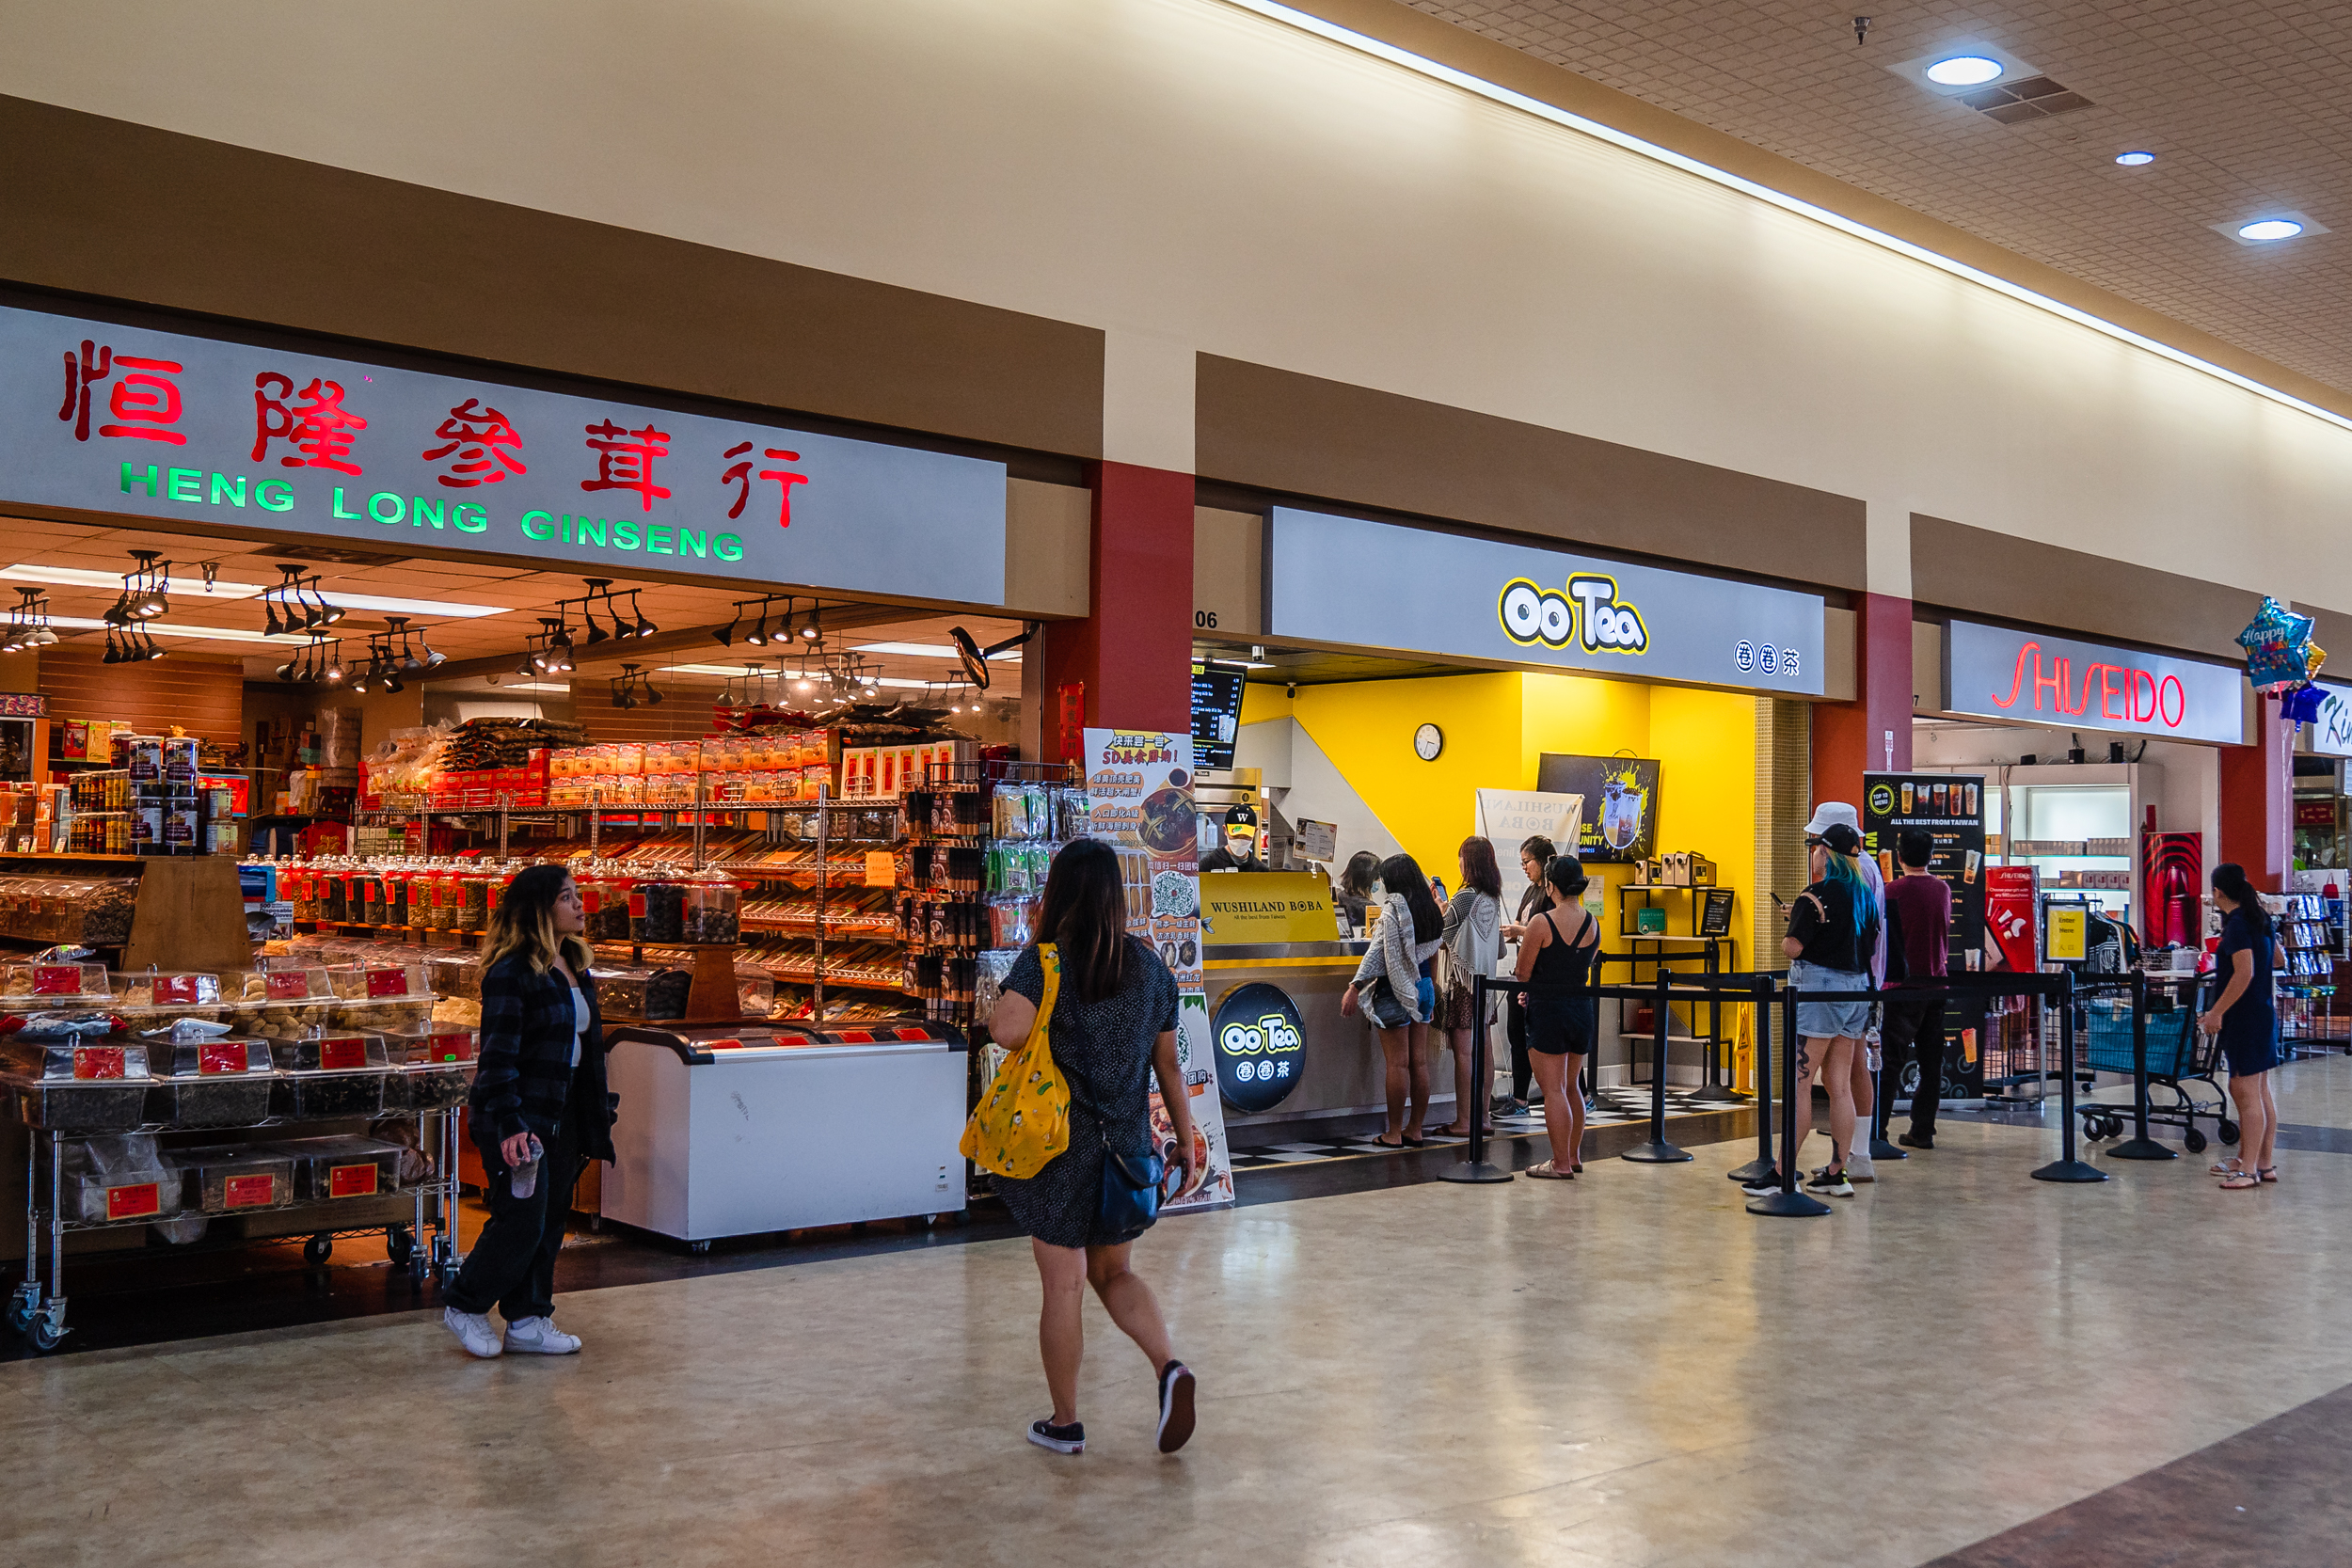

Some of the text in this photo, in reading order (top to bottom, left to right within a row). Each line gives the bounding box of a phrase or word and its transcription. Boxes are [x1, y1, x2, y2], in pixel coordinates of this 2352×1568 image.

[120, 462, 744, 562] HENG LONG GINSENG
[1196, 610, 1217, 628] 06
[1569, 575, 1646, 651] Tea
[2243, 627, 2285, 645] Happy
[1992, 641, 2185, 728] SHISEIDO
[1113, 735, 1165, 748] 快来尝一尝
[1237, 813, 1248, 822] W
[1147, 861, 1200, 872] 微信扫一扫团购
[1211, 900, 1323, 912] WUSHILAND BOBA
[1261, 1017, 1299, 1051] Tea
